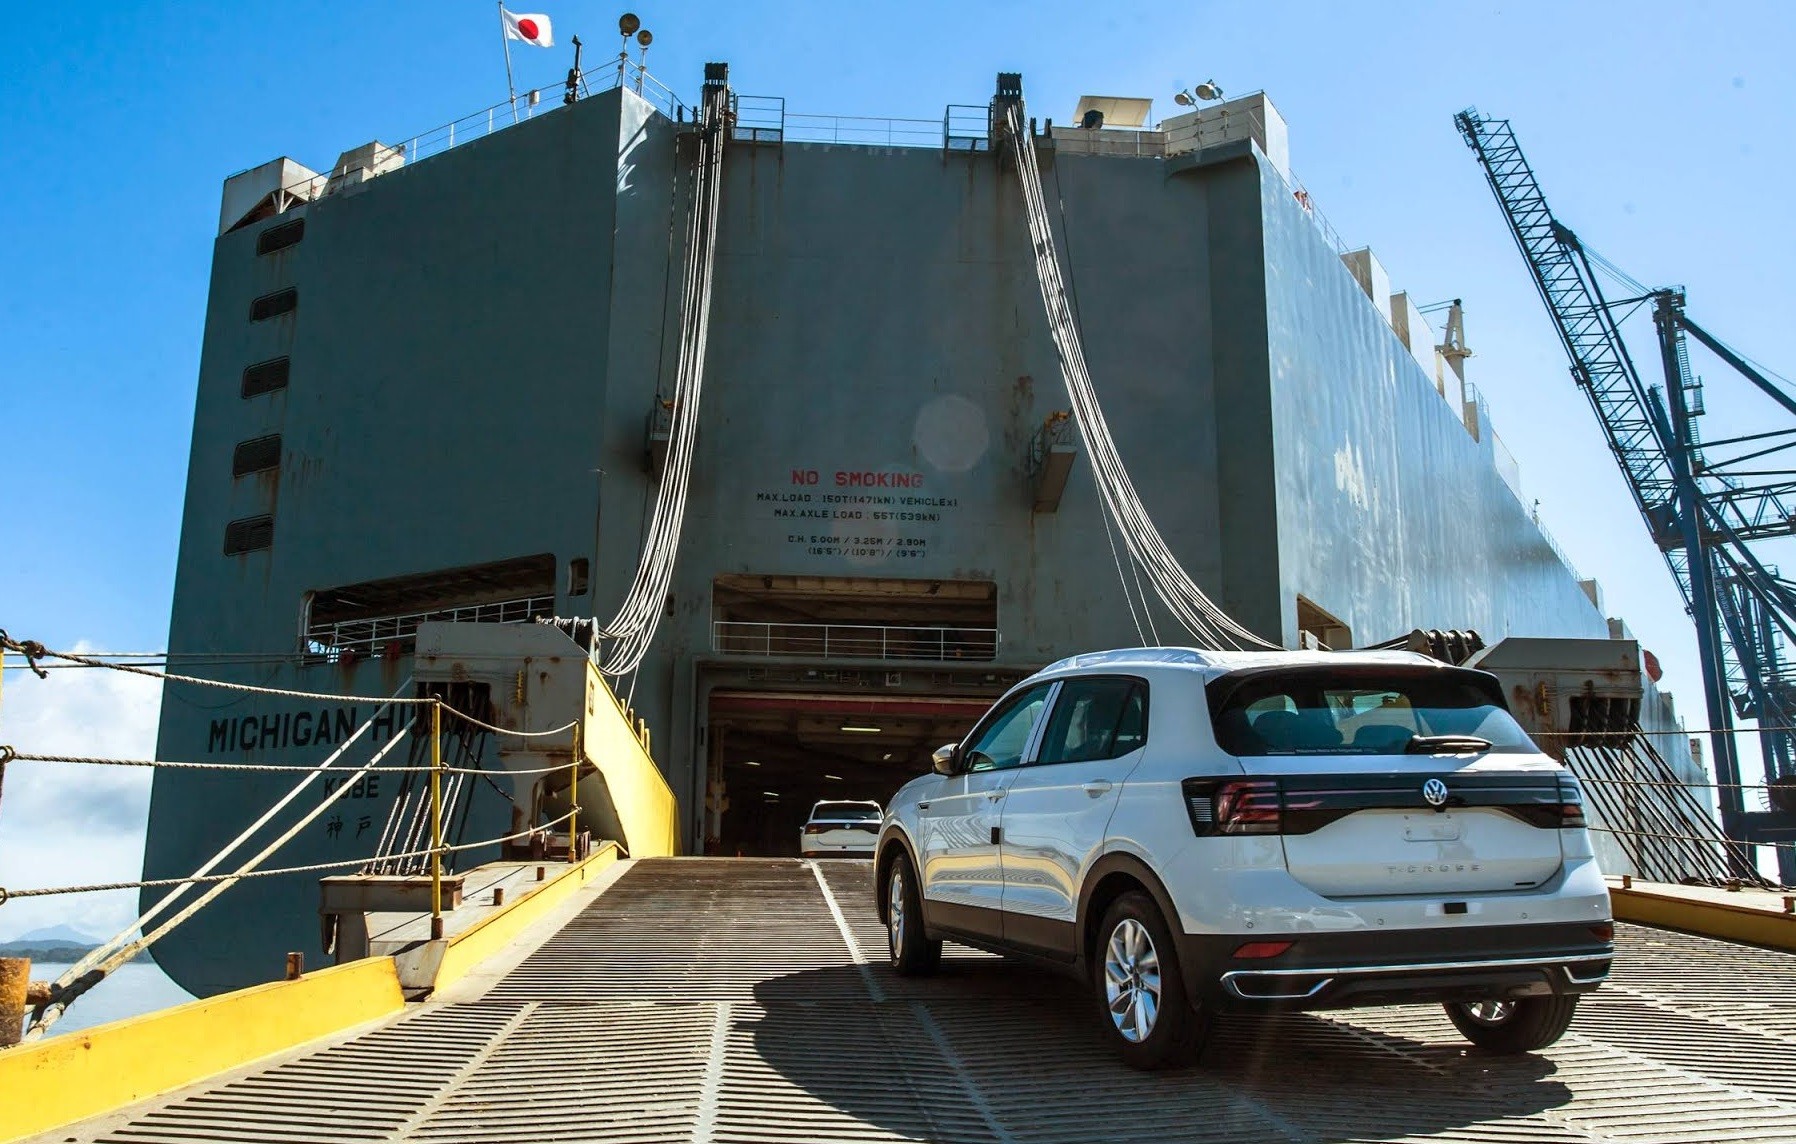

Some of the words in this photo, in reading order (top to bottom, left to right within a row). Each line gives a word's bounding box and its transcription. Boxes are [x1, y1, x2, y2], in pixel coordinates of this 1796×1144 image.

[791, 470, 819, 486] NO
[835, 471, 924, 488] SMOKING
[833, 510, 862, 519] LOAD
[810, 535, 840, 544] 5.00M
[208, 706, 357, 753] MICHIGAN
[324, 775, 380, 799] KOBE
